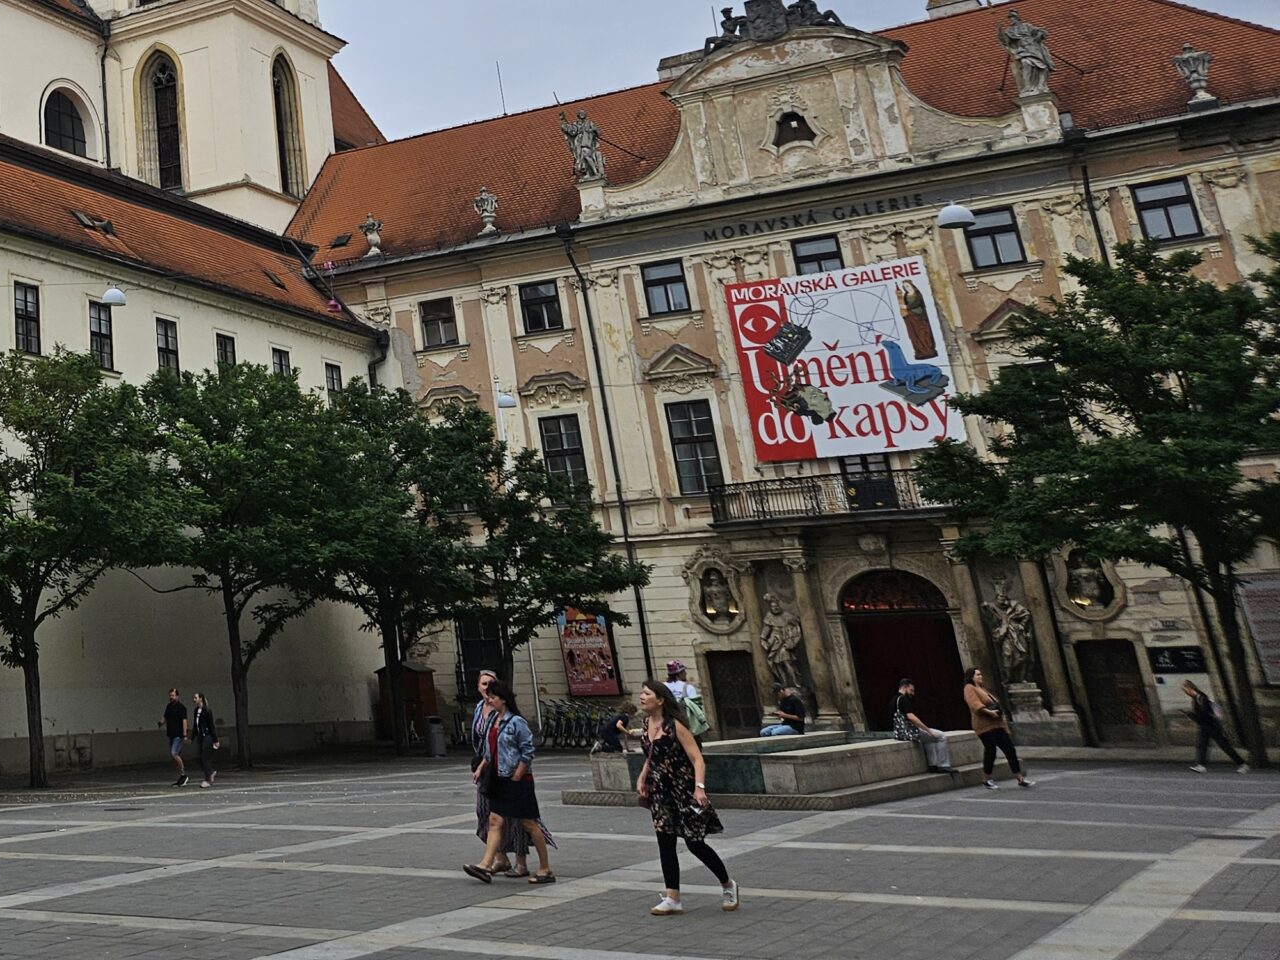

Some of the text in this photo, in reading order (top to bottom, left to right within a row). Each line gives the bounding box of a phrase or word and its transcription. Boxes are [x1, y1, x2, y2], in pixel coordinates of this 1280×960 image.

[703, 193, 924, 241] MORAVSKÁ GALERIE
[730, 261, 921, 303] MORAVSKÁ GALERIE
[742, 334, 893, 395] Umění
[757, 392, 951, 449] do kapsy
